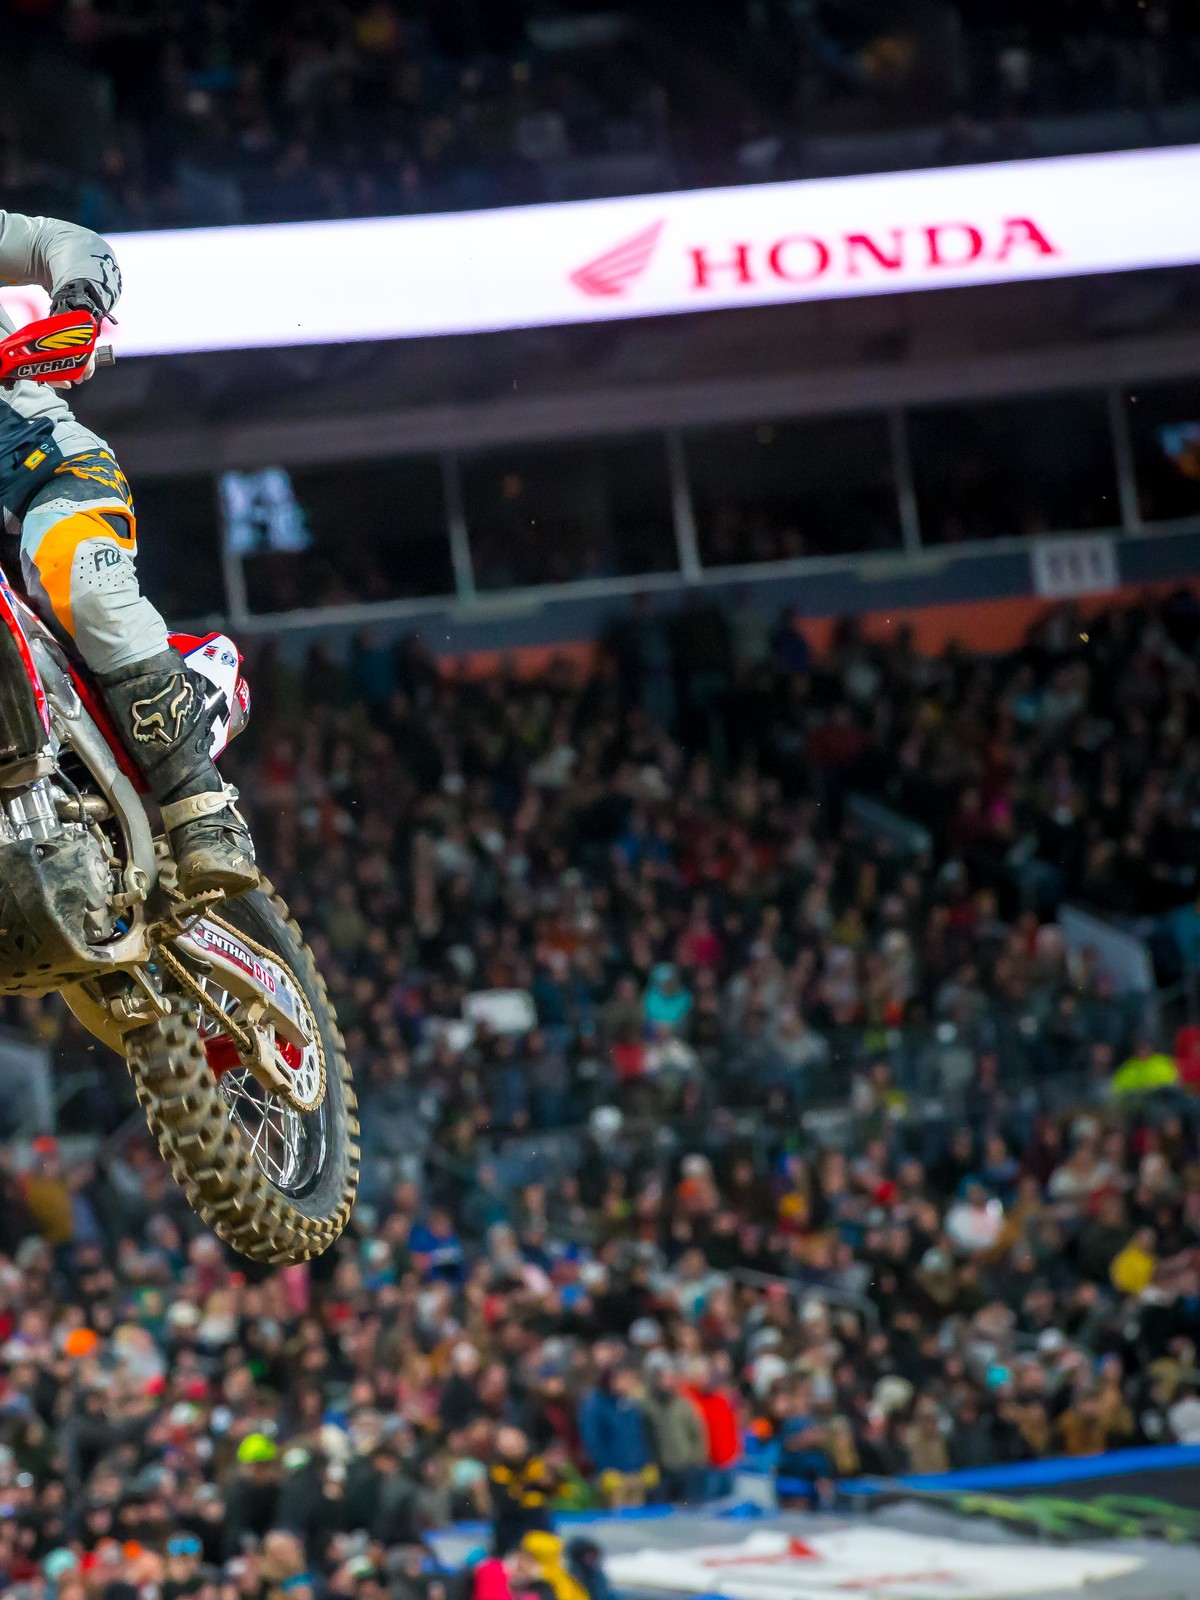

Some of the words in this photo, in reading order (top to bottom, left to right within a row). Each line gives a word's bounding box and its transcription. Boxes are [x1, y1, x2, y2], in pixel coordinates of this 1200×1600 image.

[689, 217, 1059, 288] HONDA
[18, 357, 75, 376] CYCRA
[255, 963, 275, 993] DID
